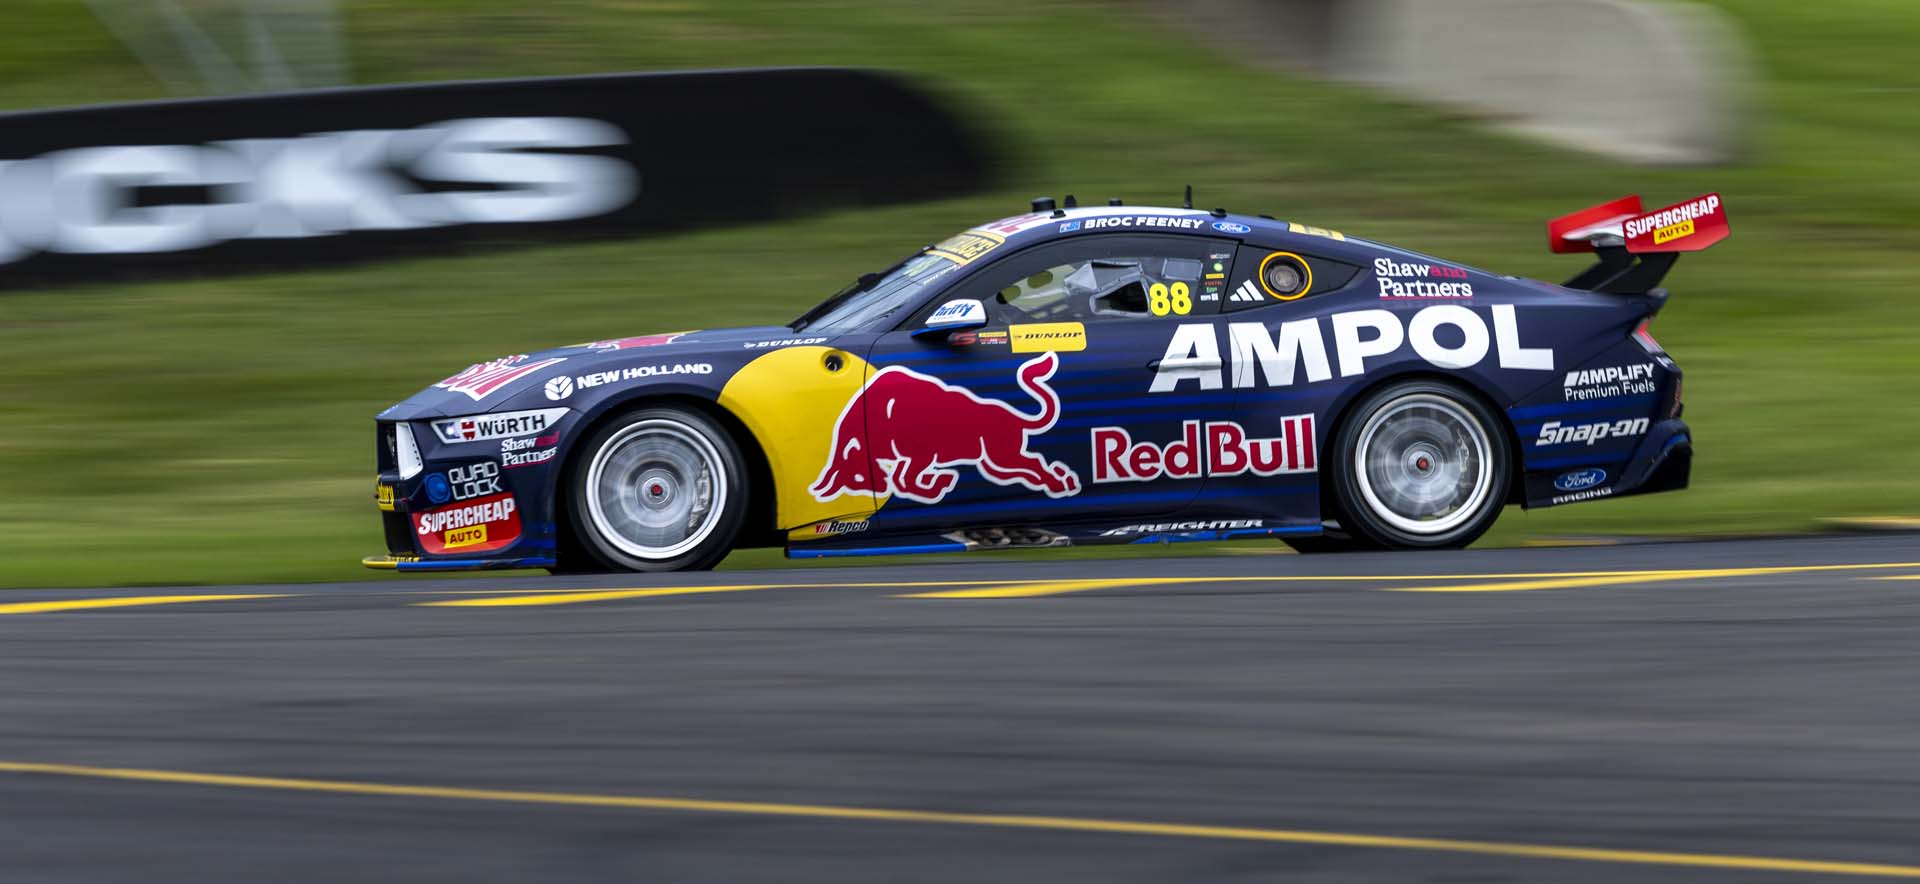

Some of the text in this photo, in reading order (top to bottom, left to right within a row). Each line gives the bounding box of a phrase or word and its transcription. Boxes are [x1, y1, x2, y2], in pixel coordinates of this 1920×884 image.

[1085, 217, 1203, 229] BROC FEENEY
[1625, 195, 1719, 239] SUPERCHEAP
[1658, 224, 1690, 240] AUTO
[1374, 258, 1430, 277] Shaw
[1377, 277, 1472, 297] Partners
[1149, 281, 1192, 316] 88
[757, 338, 827, 347] DUNLOP
[1149, 304, 1554, 392] AMPOL
[577, 363, 712, 389] NEW HOLLAND
[1577, 362, 1654, 385] AMPLIFY
[1565, 379, 1655, 401] Premium Fuels
[478, 414, 545, 436] WÜRTH
[1536, 417, 1649, 446] Snap-on
[501, 438, 537, 452] Shaw
[1091, 413, 1318, 483] Red Bull
[448, 461, 499, 484] QUAD
[1565, 472, 1595, 488] Ford
[452, 477, 503, 500] LOCK
[418, 497, 515, 535] SUPERCHEAP
[828, 520, 869, 534] Repco
[449, 530, 482, 544] AUTO
[1100, 519, 1264, 537] FREIGHTER
